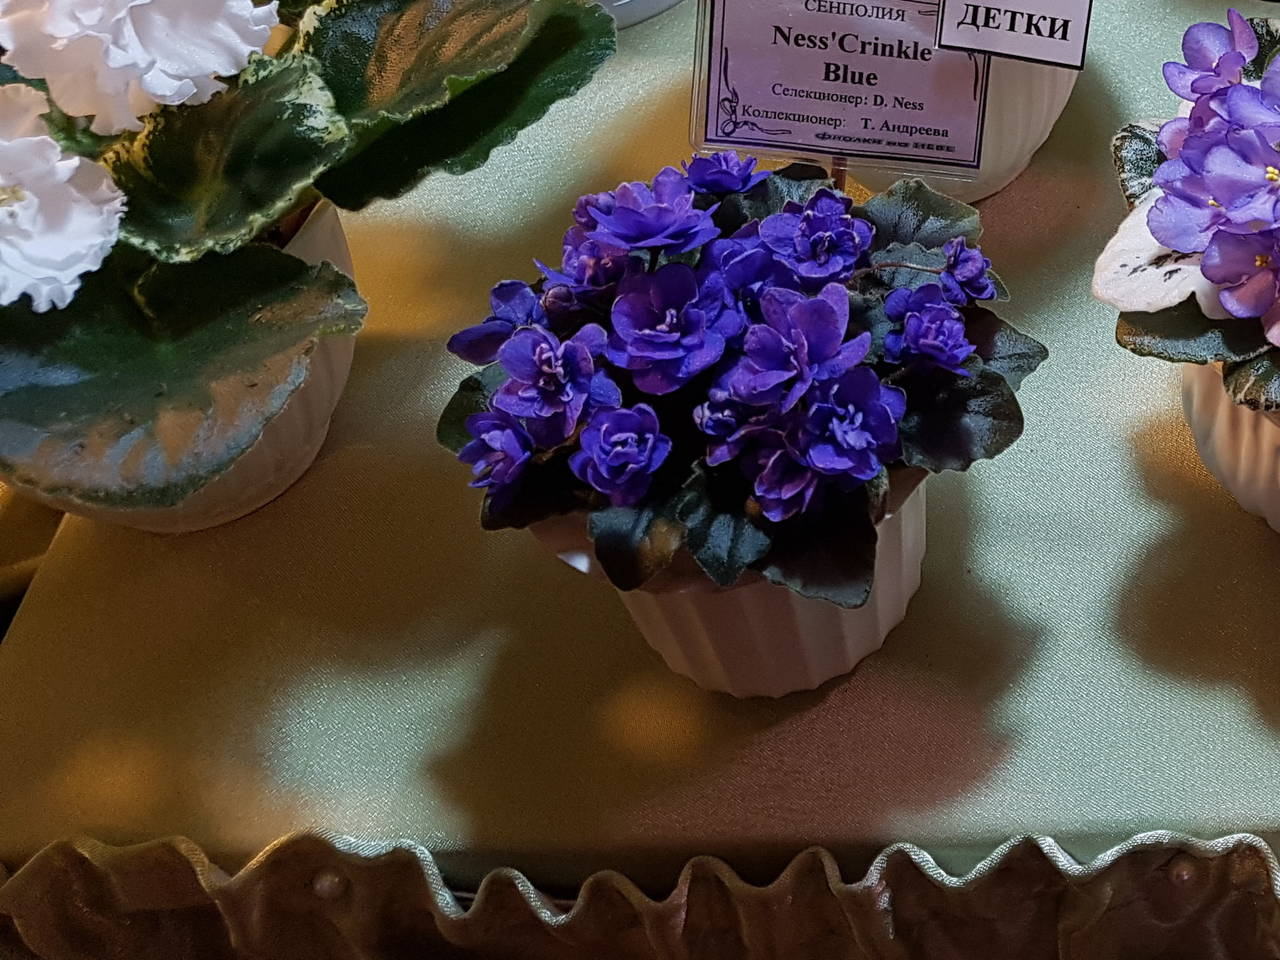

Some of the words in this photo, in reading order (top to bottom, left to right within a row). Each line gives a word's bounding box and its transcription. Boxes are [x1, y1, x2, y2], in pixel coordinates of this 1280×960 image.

[957, 4, 1072, 41] ДЕТКИ
[772, 25, 933, 62] Ness'Crinkle
[823, 62, 878, 87] Blue
[772, 83, 868, 107] Селекционер:
[873, 94, 888, 109] D.
[893, 97, 924, 111] Ness
[741, 105, 846, 128] Коллекционер:
[861, 118, 875, 130] Т.
[880, 120, 949, 138] Андреева
